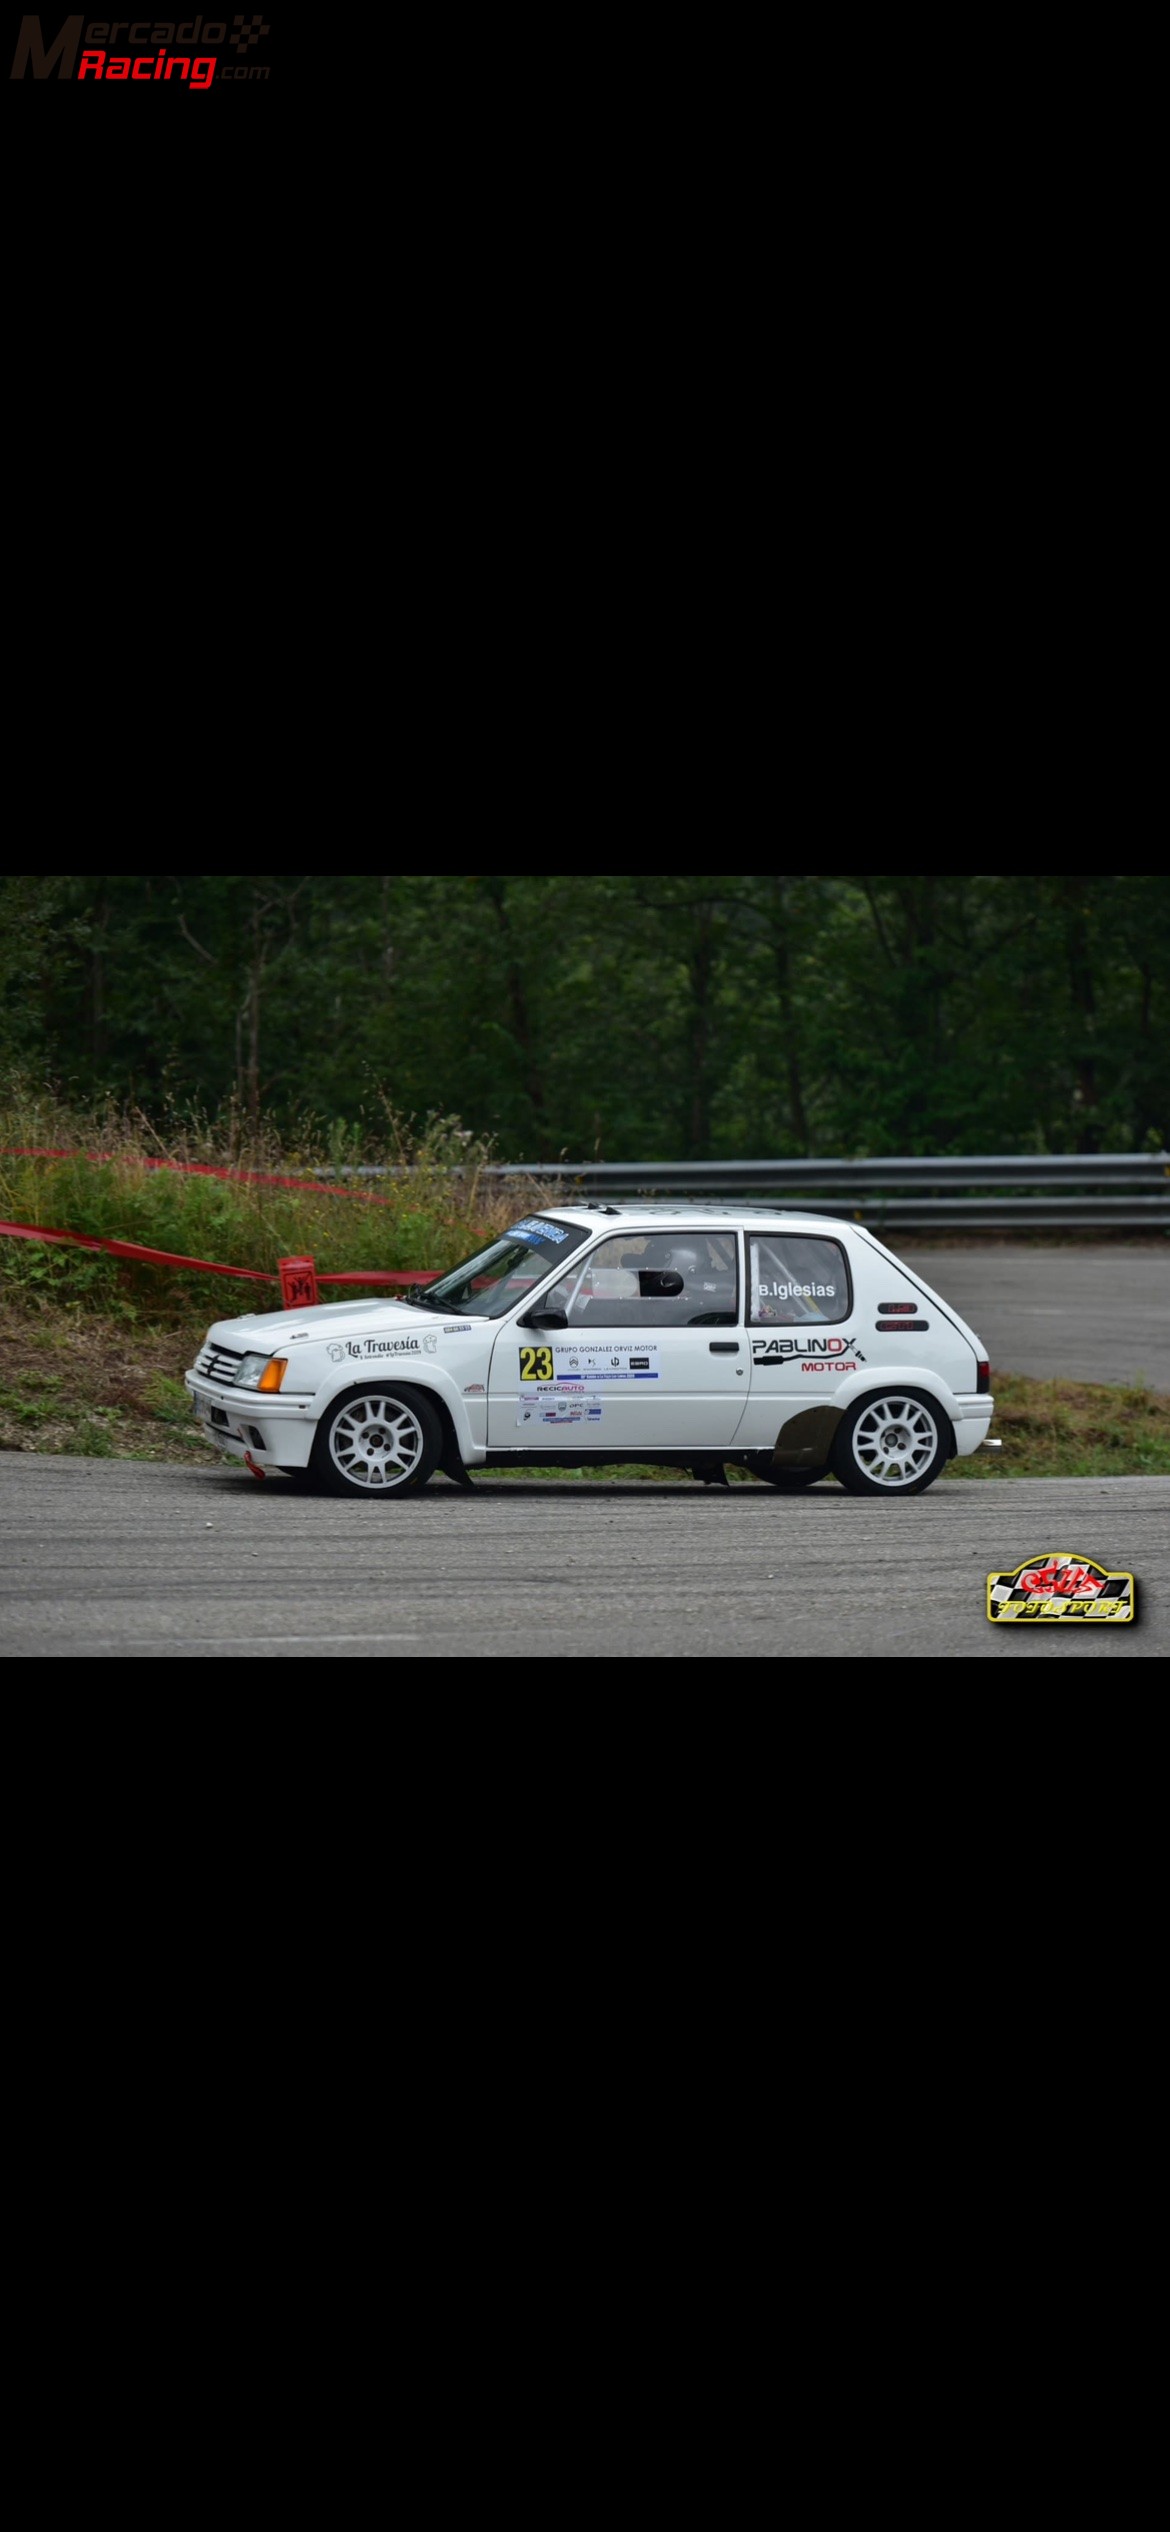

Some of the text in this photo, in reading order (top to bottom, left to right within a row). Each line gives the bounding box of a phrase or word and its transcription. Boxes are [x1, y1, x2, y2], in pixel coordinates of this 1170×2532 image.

[759, 1282, 835, 1300] B.Iglesias
[345, 1341, 361, 1358] La
[363, 1336, 420, 1353] Travesía
[752, 1338, 857, 1354] PABLINOX
[520, 1346, 553, 1380] 23
[801, 1362, 857, 1372] MOTOR
